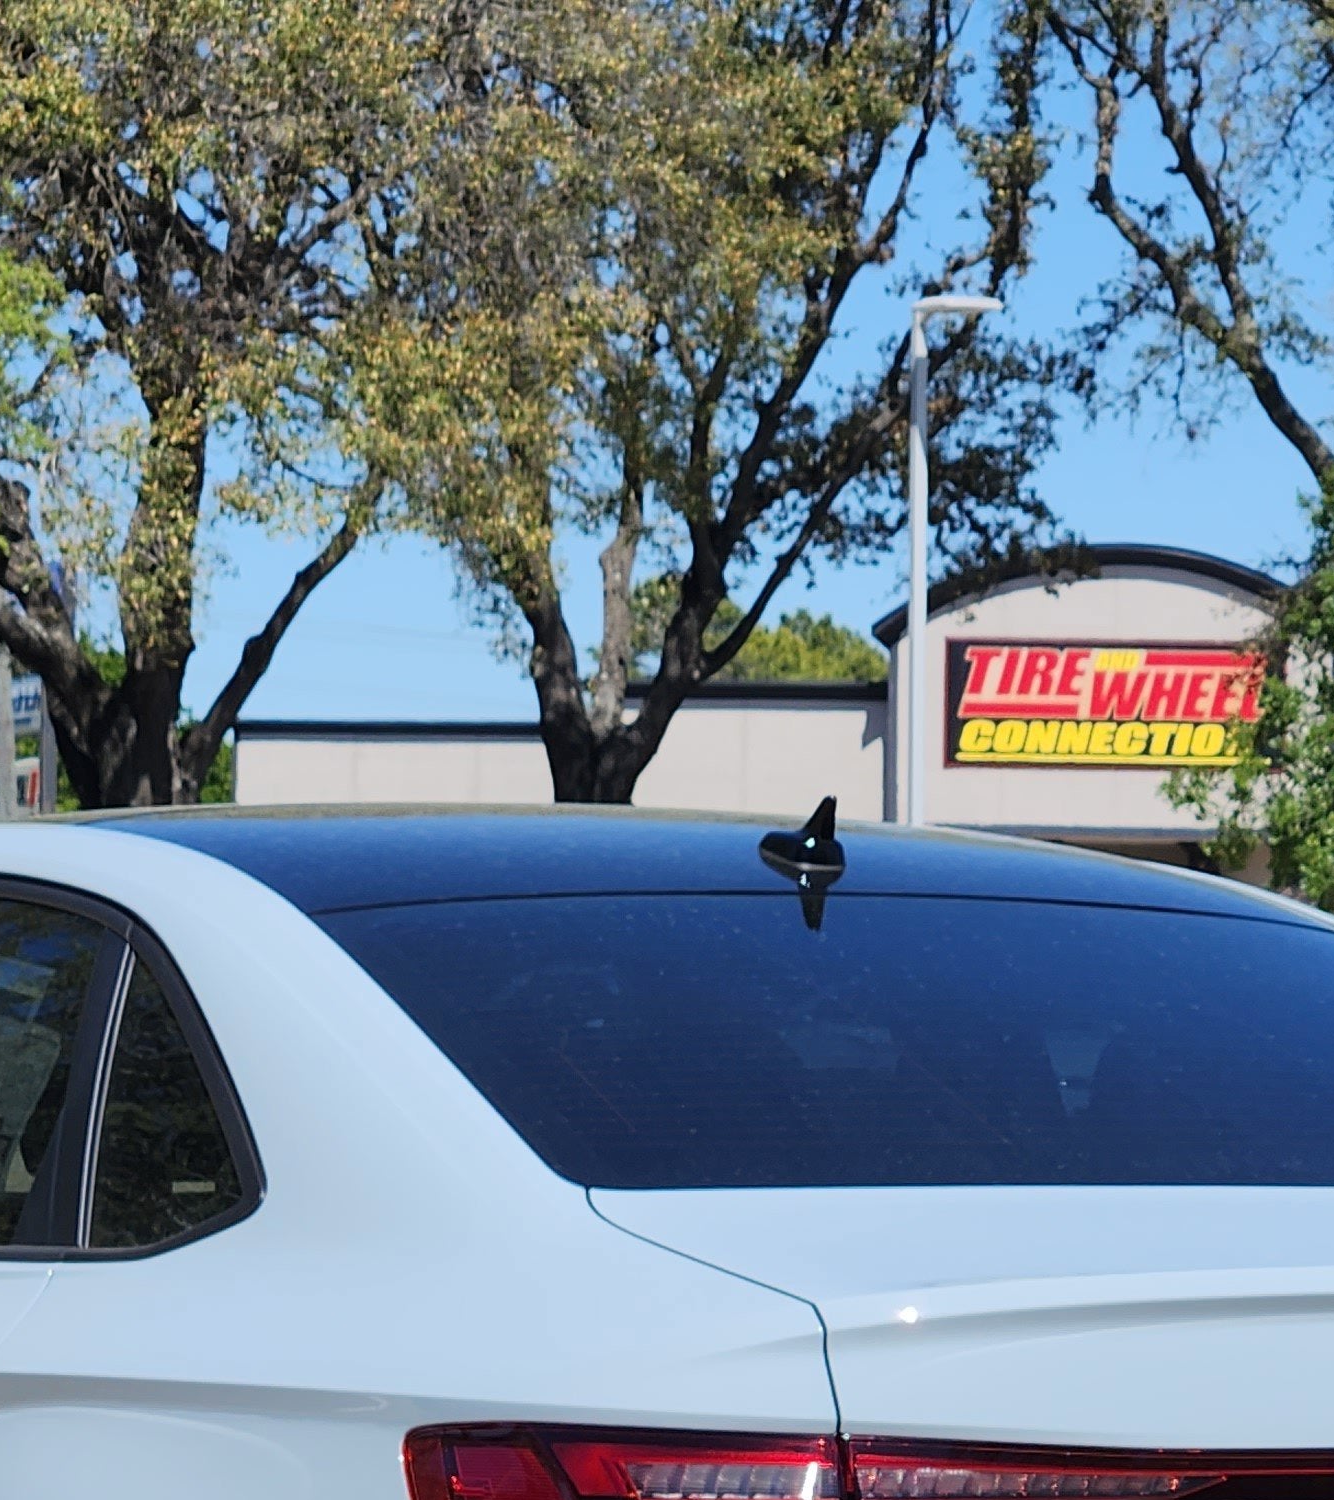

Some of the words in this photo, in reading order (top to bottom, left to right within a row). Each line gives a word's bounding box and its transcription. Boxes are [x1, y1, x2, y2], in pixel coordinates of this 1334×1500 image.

[967, 648, 1090, 697] TIRE
[1096, 651, 1139, 672] AND
[1089, 670, 1262, 722] WHEEL
[959, 719, 1240, 757] CONNECTIO
